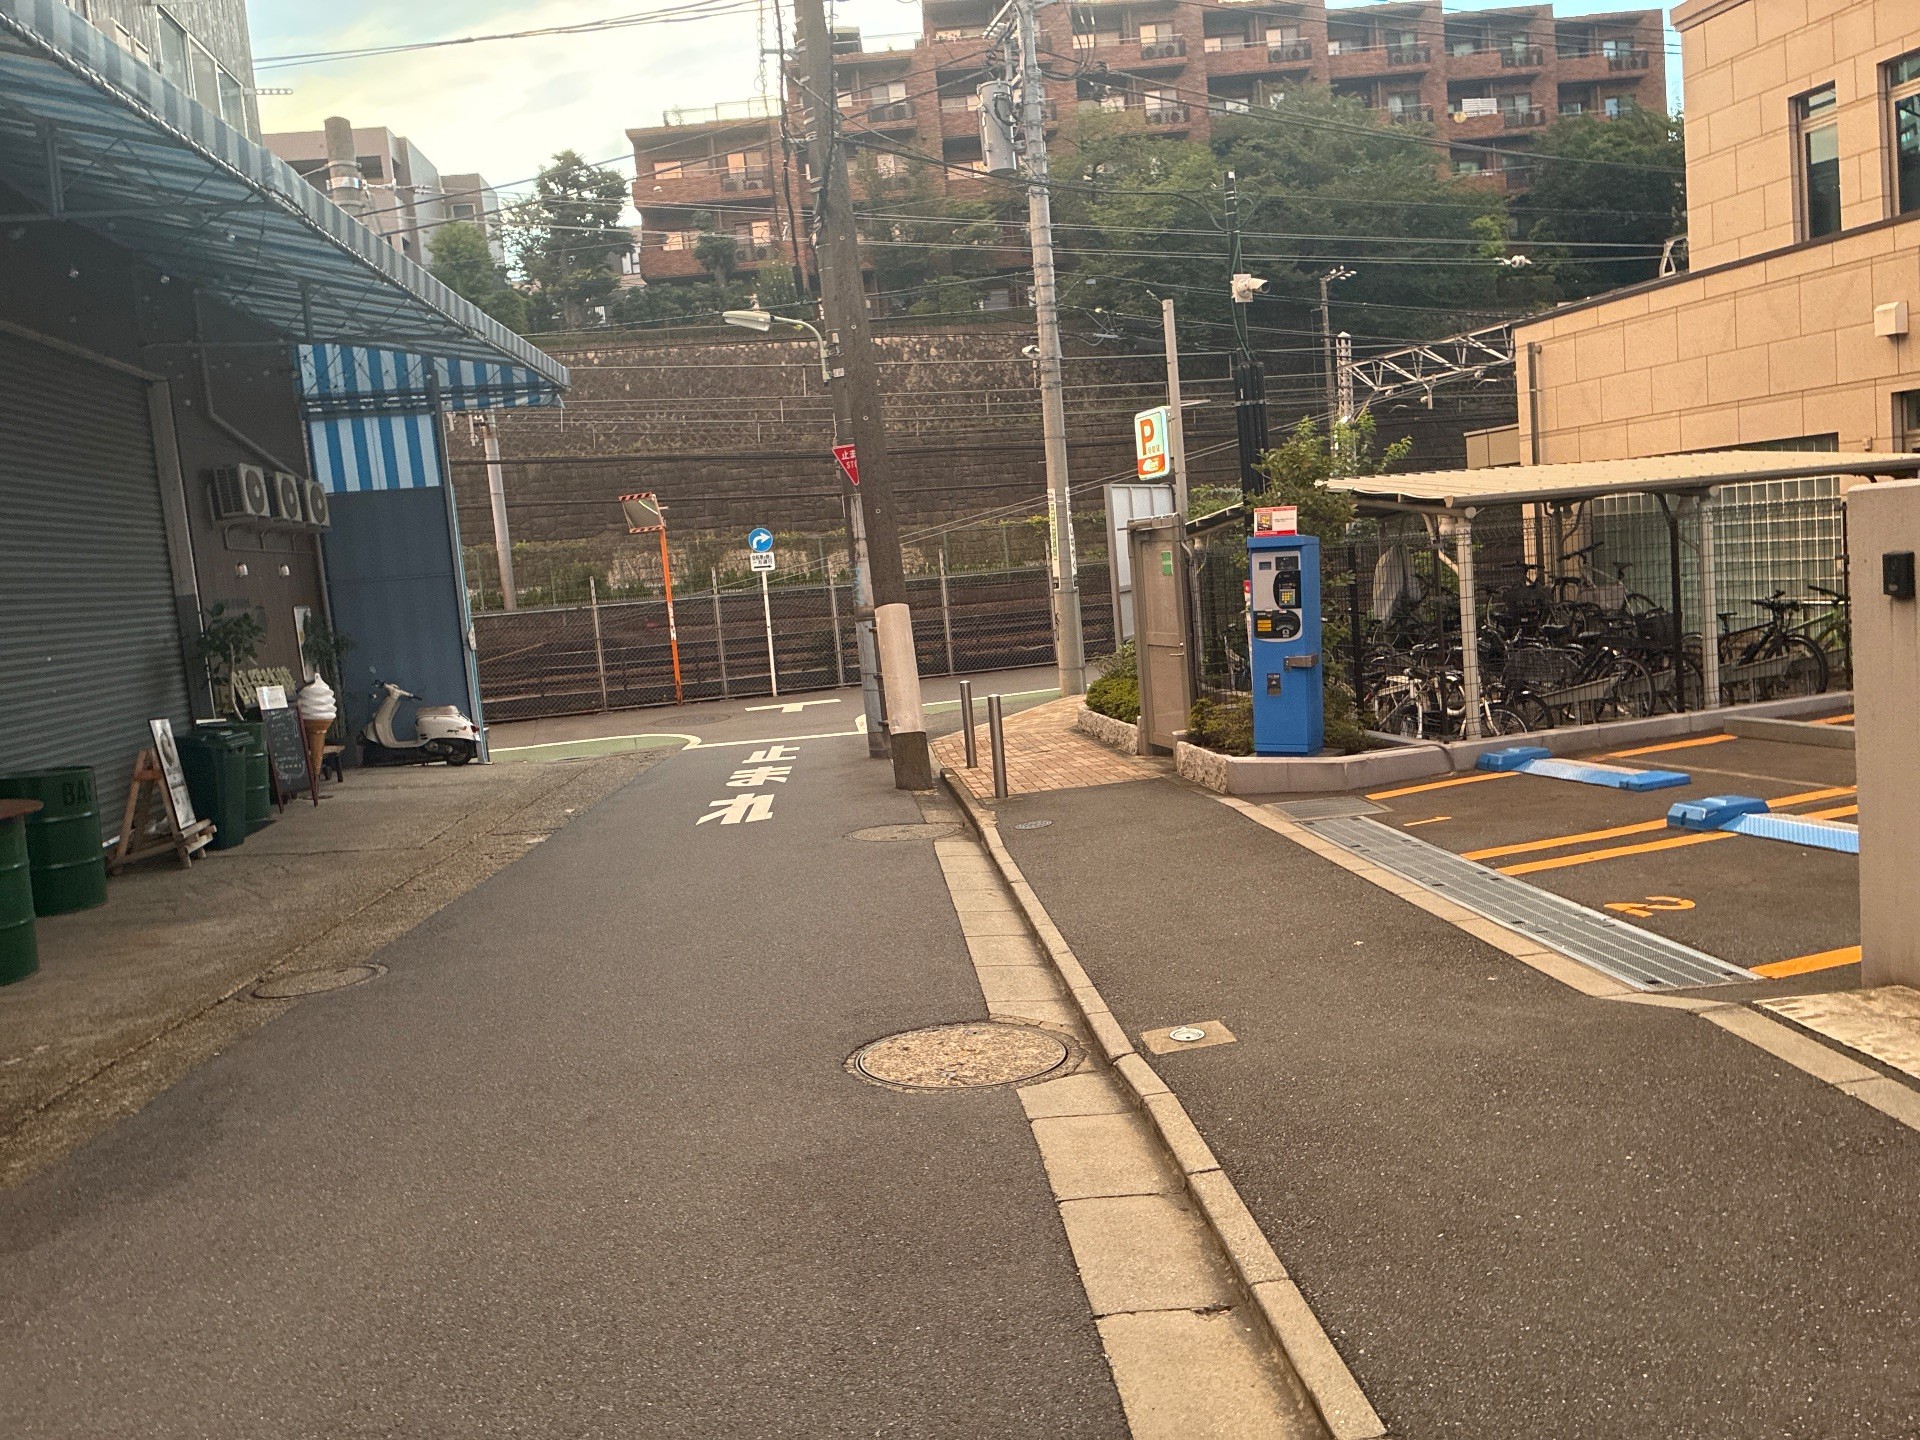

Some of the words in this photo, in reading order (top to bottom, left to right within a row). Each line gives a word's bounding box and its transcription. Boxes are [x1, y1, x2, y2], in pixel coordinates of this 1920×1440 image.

[1140, 418, 1155, 456] P
[841, 449, 857, 461] 止ま
[695, 745, 801, 826] 止まれ
[1603, 895, 1696, 918] 2
